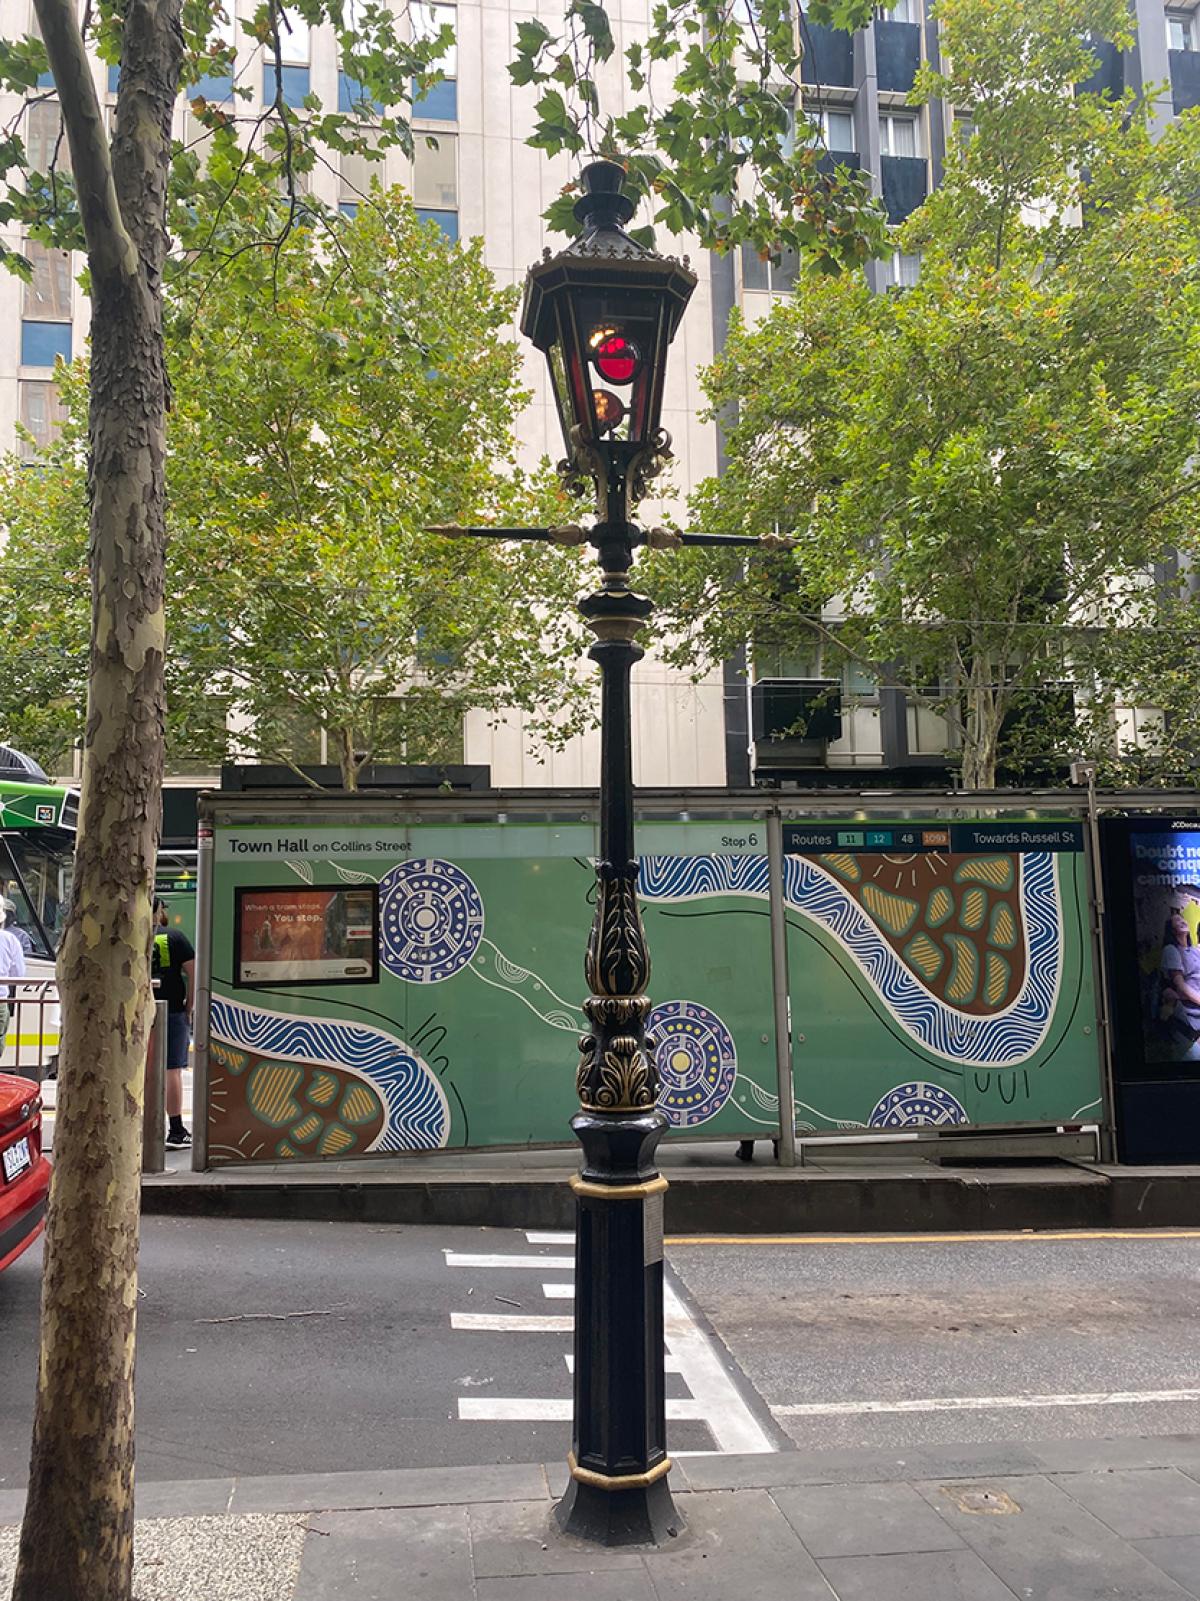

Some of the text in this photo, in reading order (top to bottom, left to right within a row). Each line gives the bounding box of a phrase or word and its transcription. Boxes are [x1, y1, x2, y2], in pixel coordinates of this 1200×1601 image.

[721, 832, 759, 849] Stop 6
[791, 833, 832, 846] Routes
[873, 833, 886, 844] 12
[901, 833, 914, 844] 48
[973, 831, 1075, 844] Towards Russell St
[228, 838, 412, 853] Town Hall on Collins Street
[1135, 844, 1185, 858] Doubt
[274, 914, 294, 922] You
